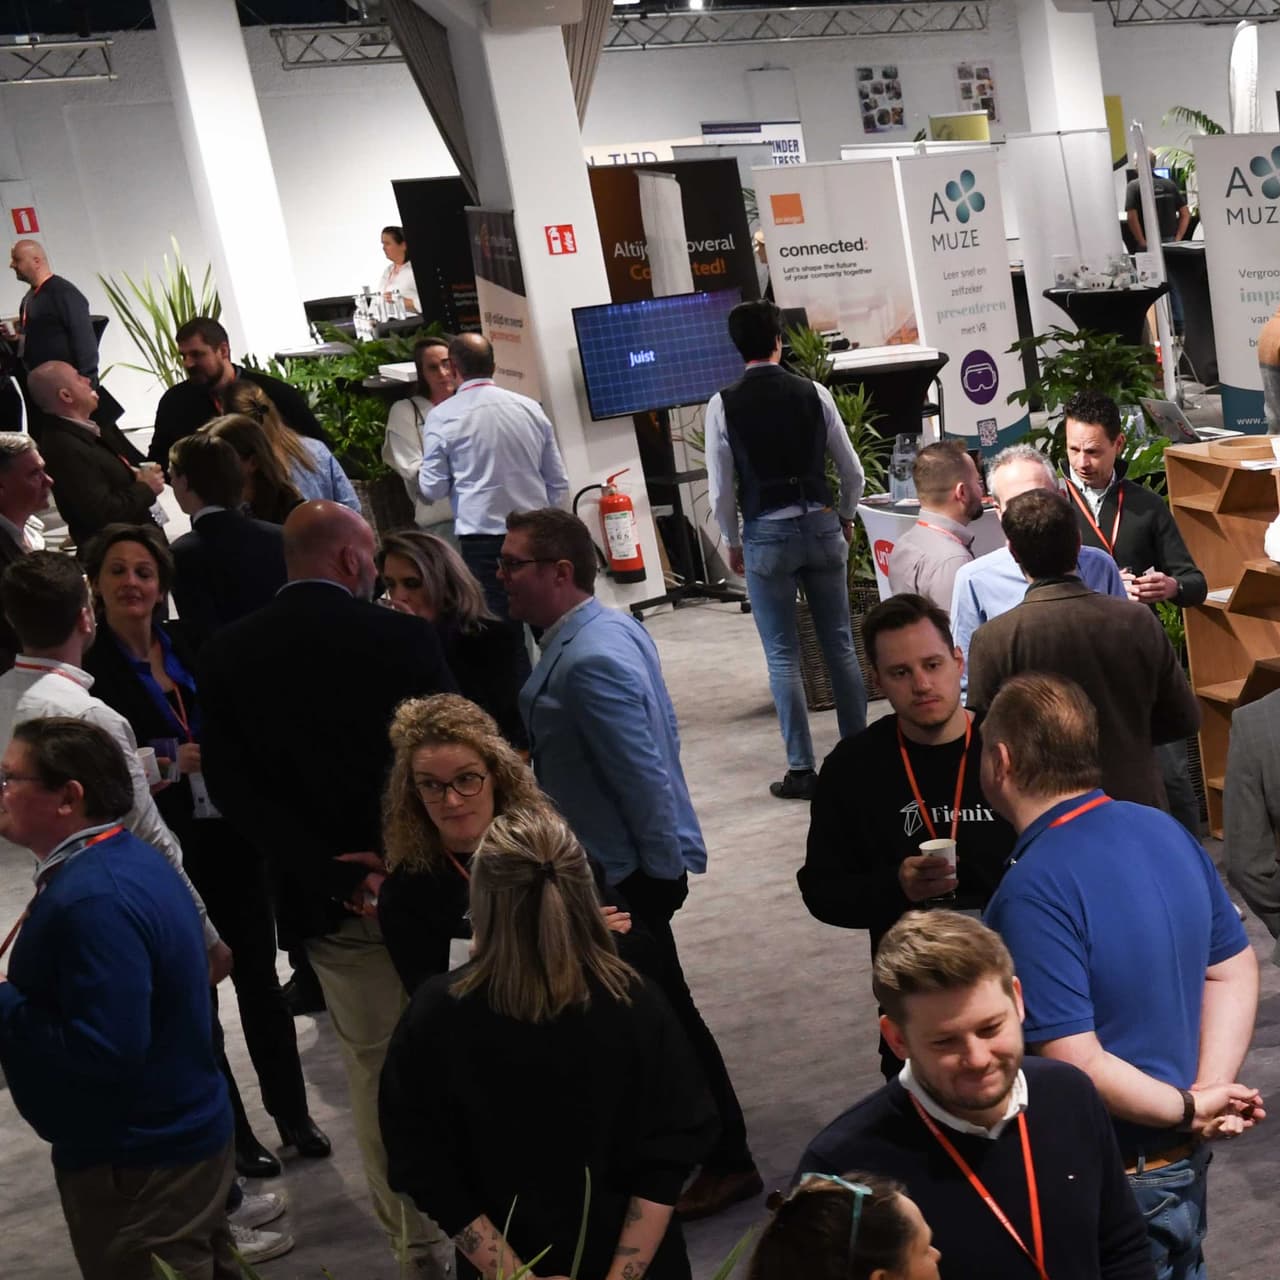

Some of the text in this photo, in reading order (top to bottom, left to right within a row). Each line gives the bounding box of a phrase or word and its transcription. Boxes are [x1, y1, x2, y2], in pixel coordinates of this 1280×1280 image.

[762, 139, 800, 154] INDER
[686, 233, 735, 252] overal
[931, 229, 980, 252] MUZE
[794, 273, 809, 282] your
[810, 270, 842, 279] company
[843, 267, 872, 277] together
[801, 262, 822, 273] shape
[824, 261, 835, 270] the
[836, 261, 857, 269] future
[943, 269, 959, 281] Leer
[977, 267, 987, 276] en
[936, 299, 1007, 325] presenteren
[1250, 314, 1269, 324] van
[961, 325, 976, 336] met
[629, 349, 656, 368] Juist
